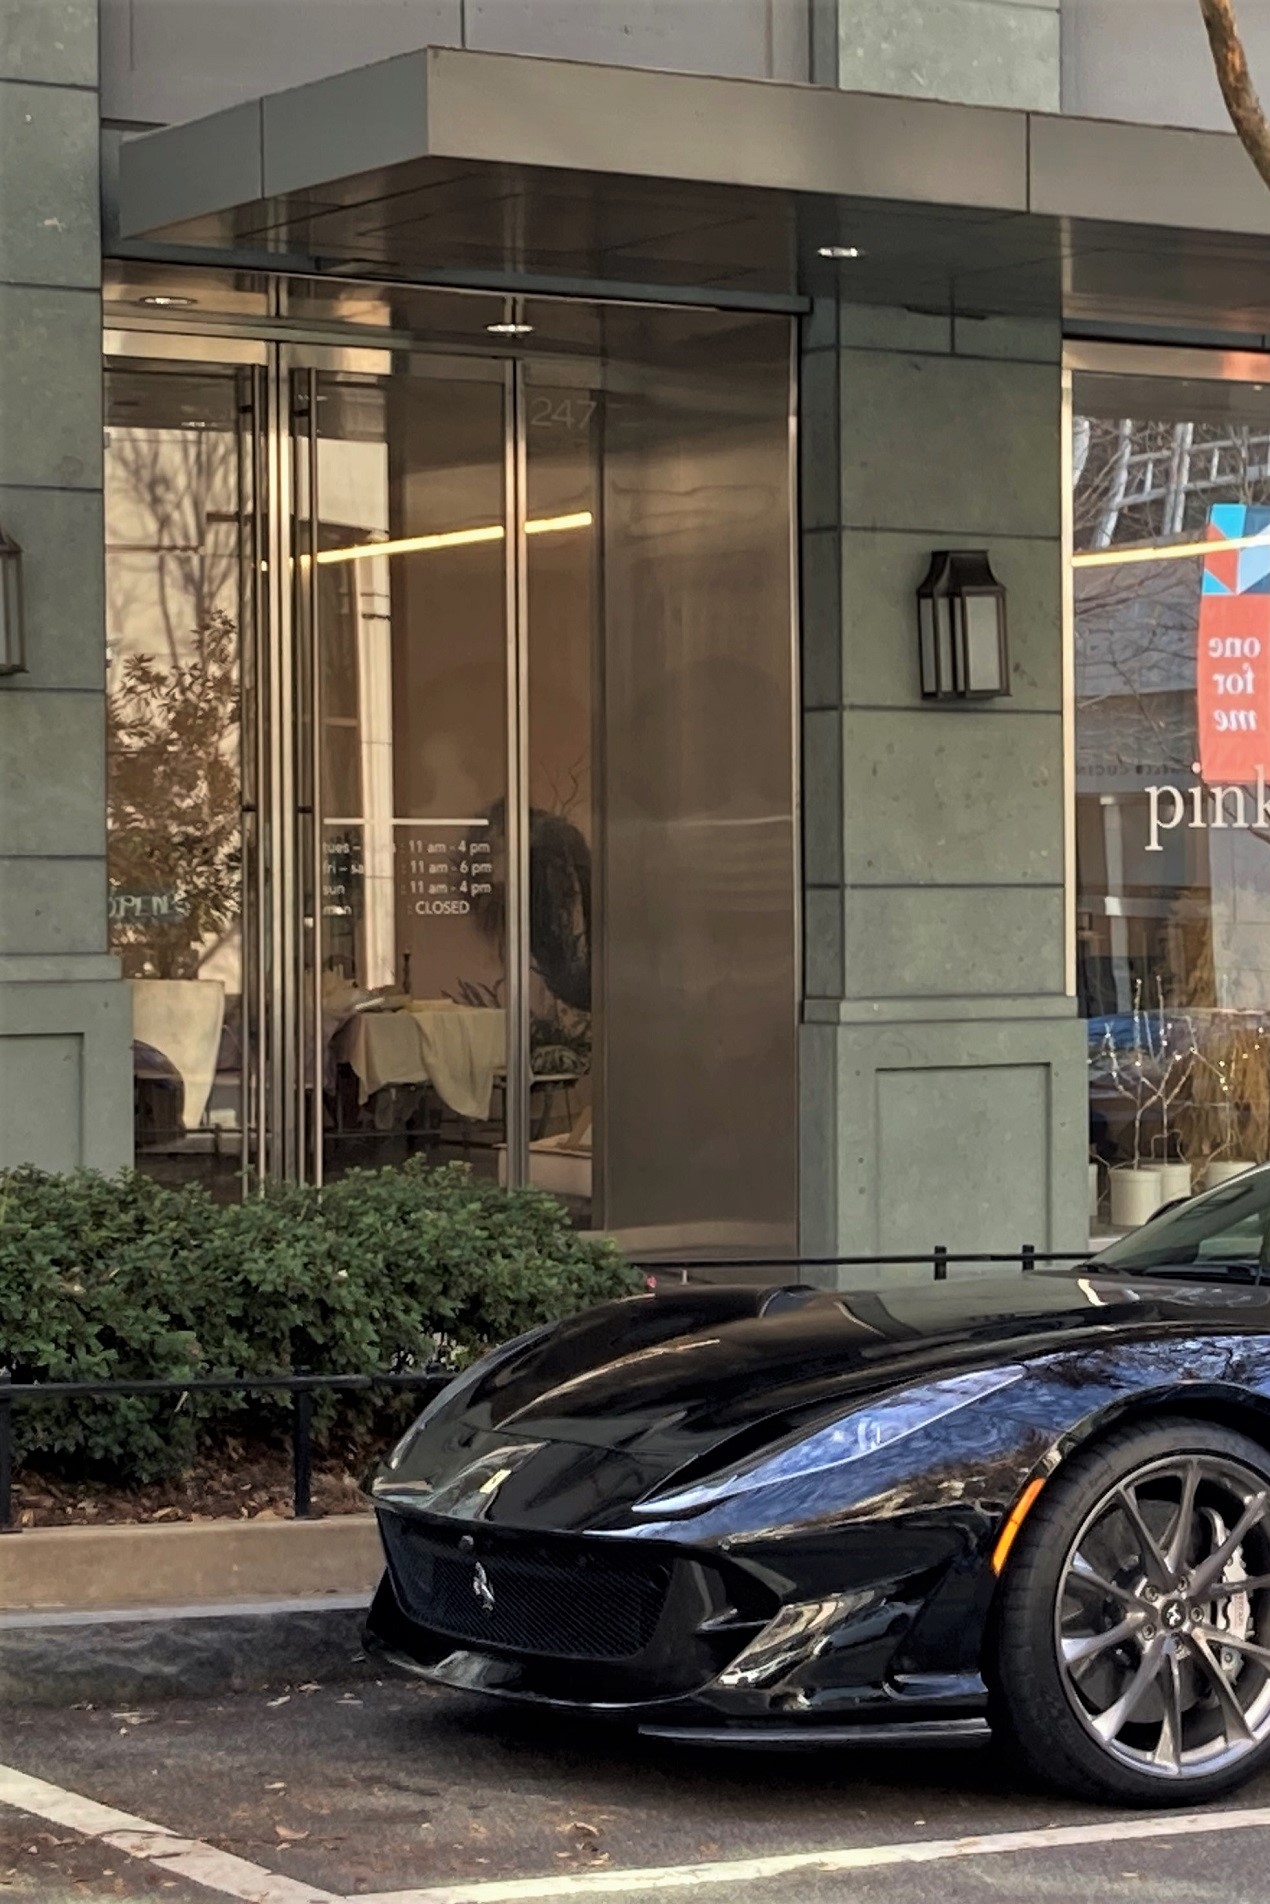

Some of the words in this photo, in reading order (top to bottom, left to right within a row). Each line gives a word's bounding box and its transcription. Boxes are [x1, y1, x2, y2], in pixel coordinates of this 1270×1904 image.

[530, 396, 598, 429] 247
[409, 840, 423, 852] 11
[427, 843, 446, 853] am
[458, 840, 467, 852] 4
[469, 843, 490, 856] pm
[410, 860, 424, 873] 11
[429, 864, 448, 873] am
[459, 861, 469, 873] 6
[471, 863, 492, 877] pm
[323, 884, 345, 895] sun
[410, 880, 424, 893] 11
[428, 884, 448, 894] am
[459, 880, 468, 894] 4
[471, 883, 492, 897] pm
[415, 900, 470, 915] CLOSED
